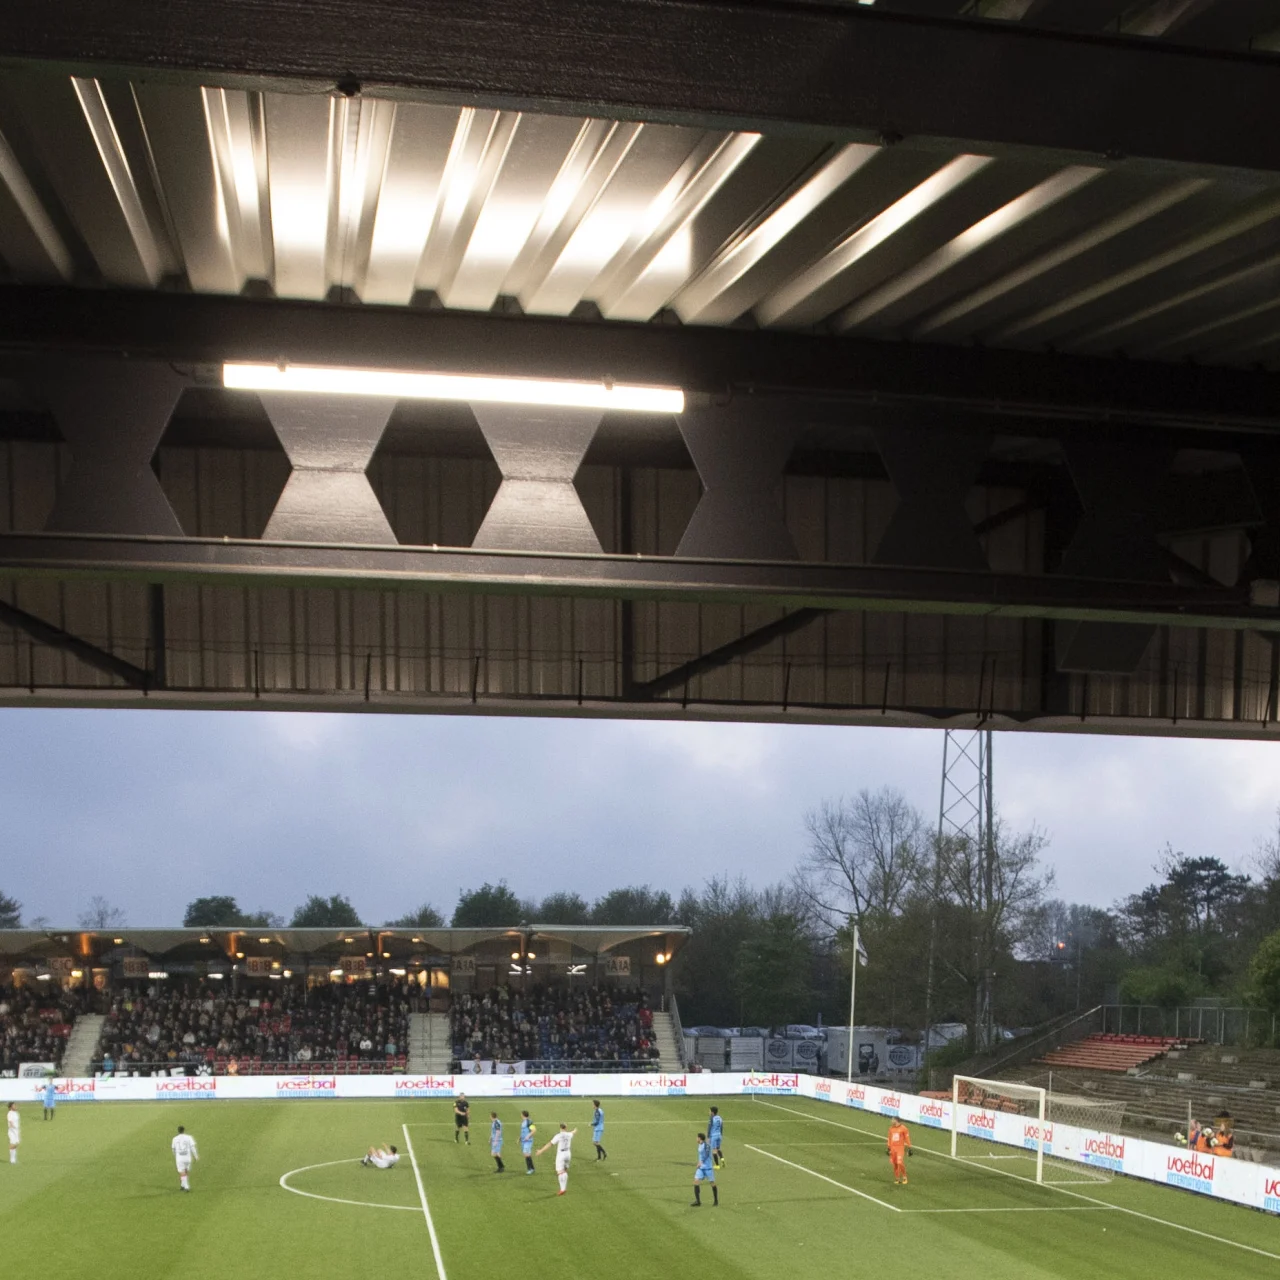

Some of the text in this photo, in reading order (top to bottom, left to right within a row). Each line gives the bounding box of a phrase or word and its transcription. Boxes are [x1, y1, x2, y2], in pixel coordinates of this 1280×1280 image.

[156, 1076, 216, 1091] voetbal
[277, 1076, 336, 1090] voetbal
[395, 1075, 454, 1089] voetbal
[514, 1074, 571, 1088] voetbal
[630, 1074, 687, 1088] voetbal
[743, 1073, 798, 1087] voetbal
[968, 1109, 995, 1129] voetbal
[1085, 1134, 1124, 1159] voetbal
[1167, 1152, 1214, 1181] voetbal
[1167, 1171, 1212, 1195] INTERNATIONAL
